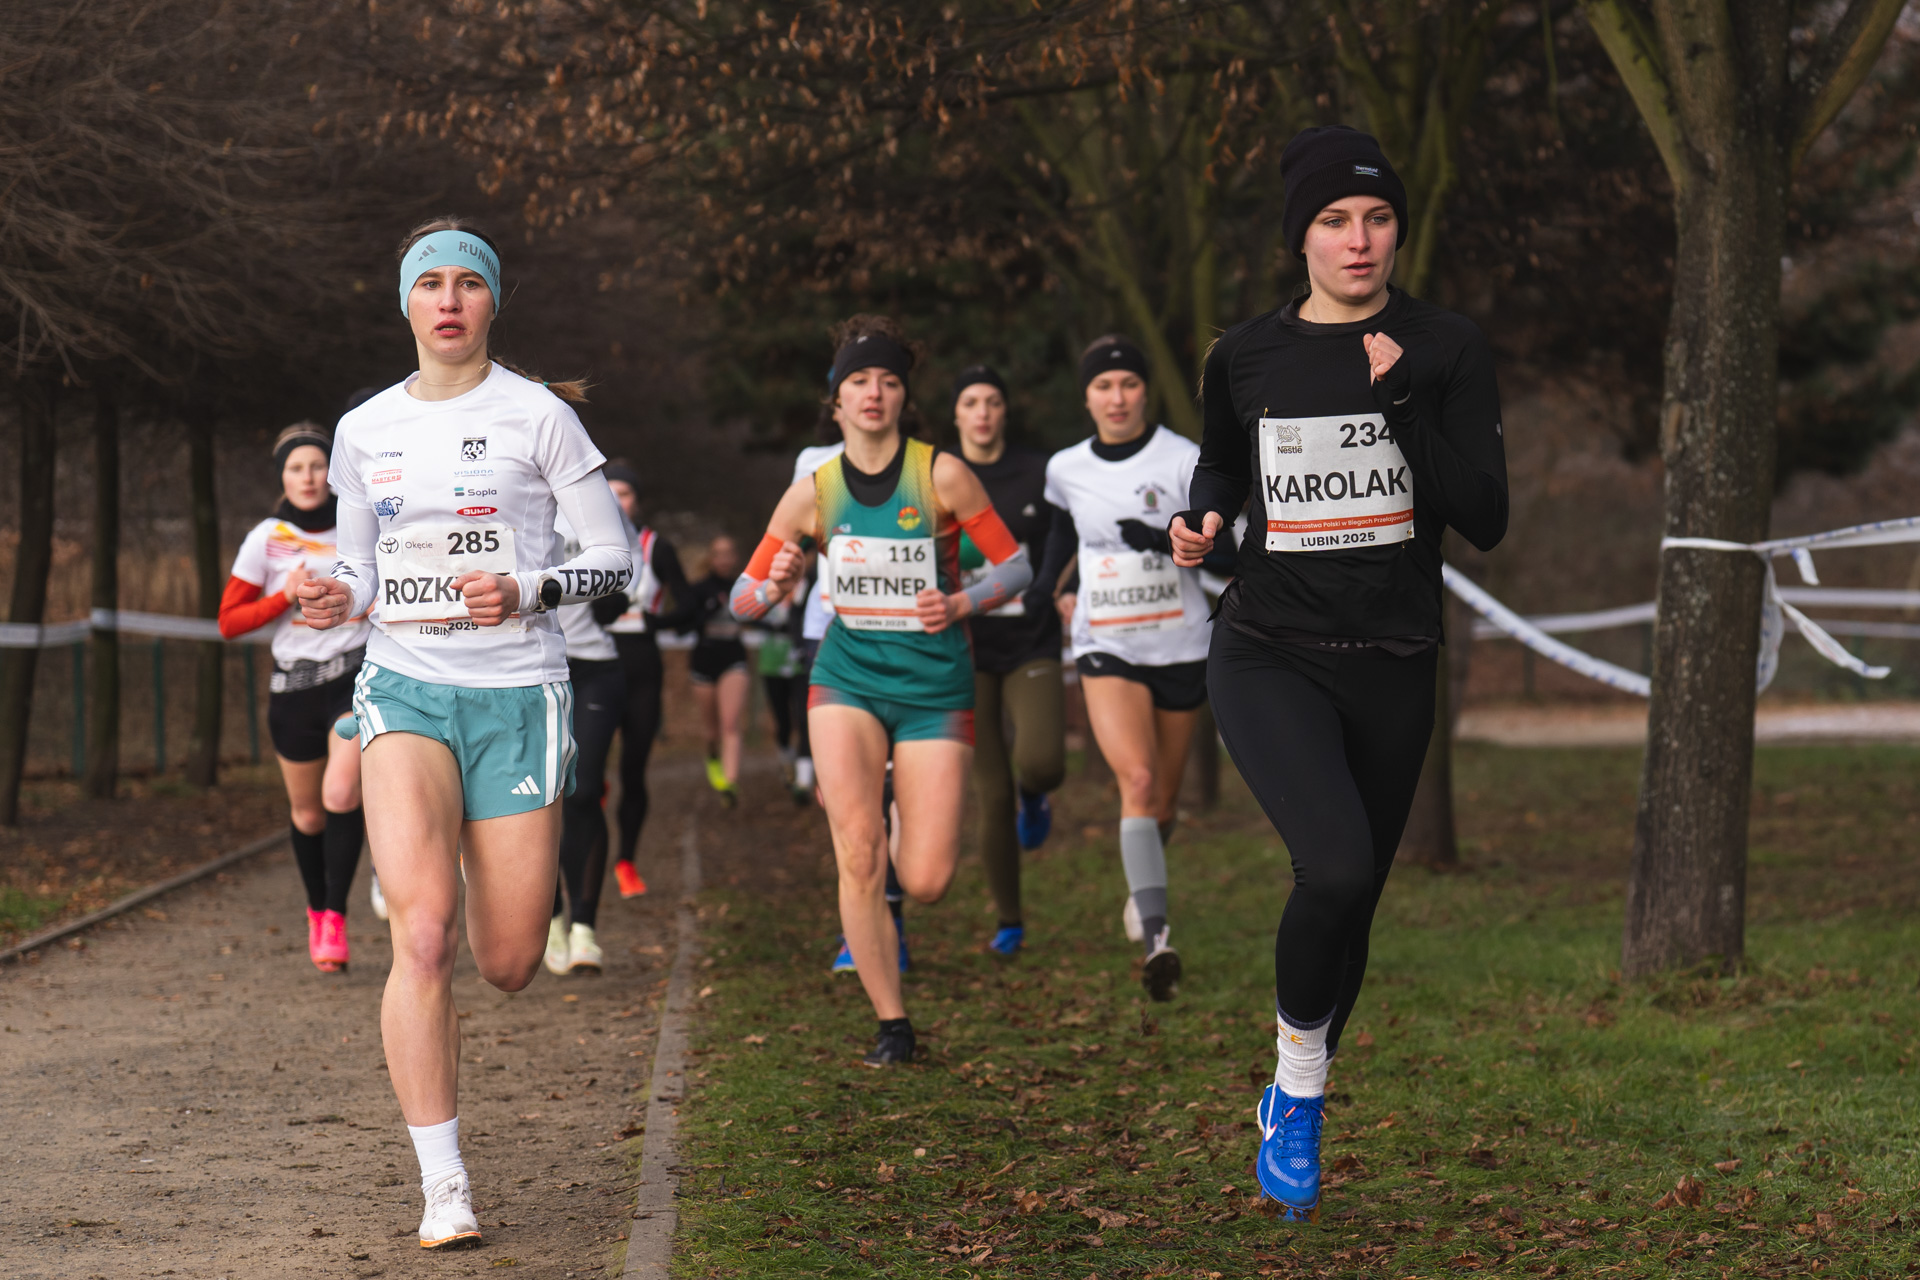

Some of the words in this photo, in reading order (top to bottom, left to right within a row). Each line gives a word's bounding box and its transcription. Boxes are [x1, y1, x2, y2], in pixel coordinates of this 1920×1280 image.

[458, 241, 499, 287] RUNNING
[1339, 422, 1395, 448] 234
[467, 488, 497, 497] Sopla
[1266, 466, 1408, 503] KAROLAK
[1289, 522, 1322, 530] Mistrzostwa
[1348, 518, 1373, 527] Biegach
[405, 541, 433, 550] Okęcie
[447, 530, 500, 555] 285
[1301, 536, 1340, 547] LUBIN
[1343, 531, 1376, 544] 2025
[889, 545, 926, 562] 116
[1142, 553, 1164, 571] 82
[1091, 582, 1178, 608] BALCERZAK
[420, 625, 449, 636] LUBIN
[449, 621, 479, 631] 2025
